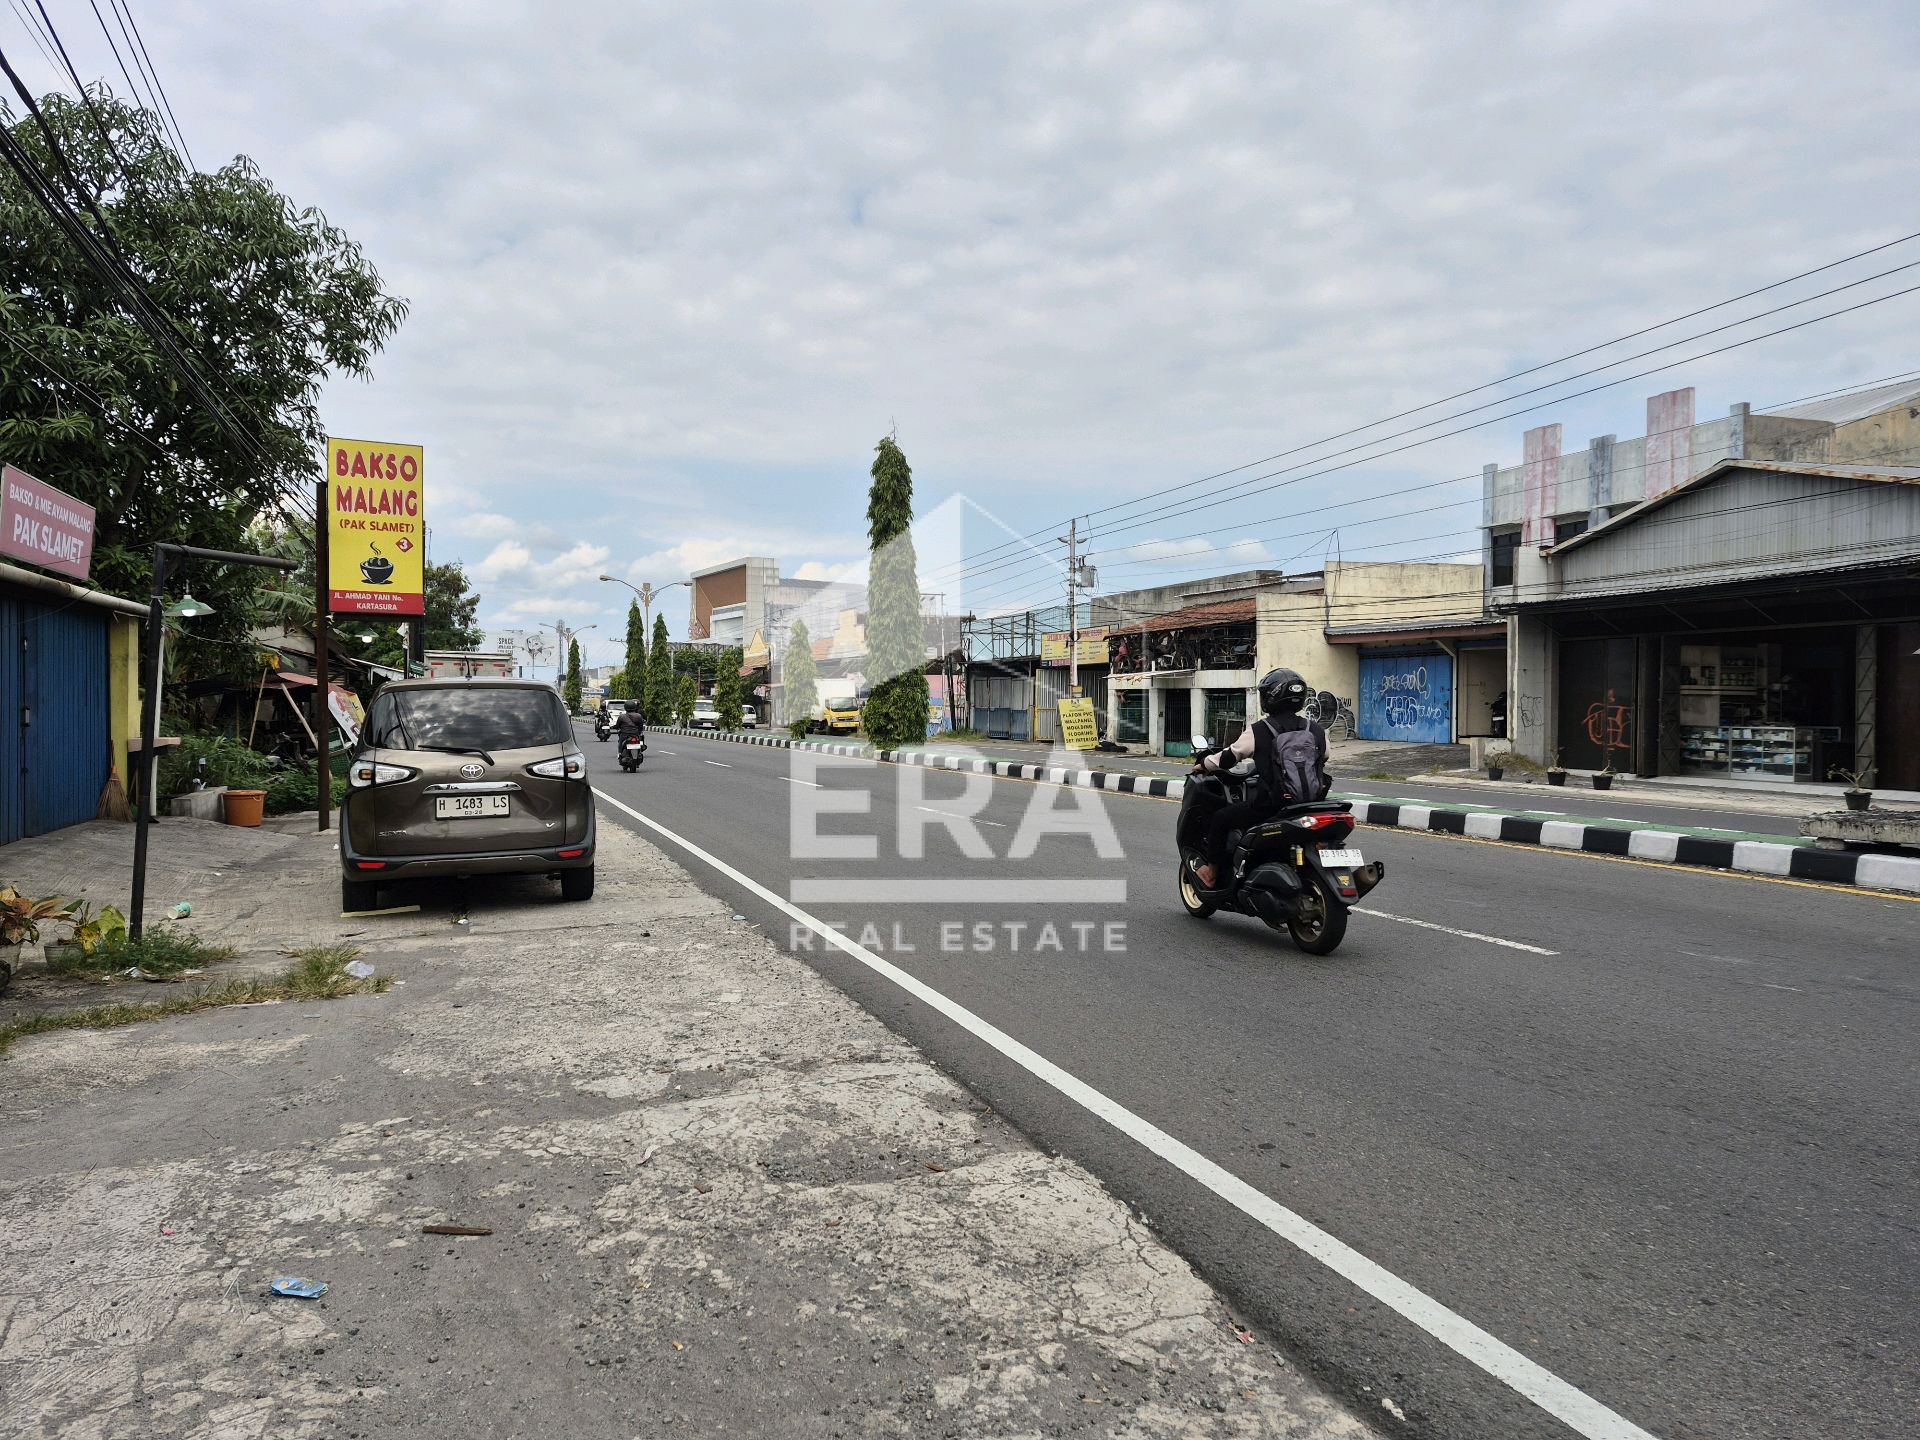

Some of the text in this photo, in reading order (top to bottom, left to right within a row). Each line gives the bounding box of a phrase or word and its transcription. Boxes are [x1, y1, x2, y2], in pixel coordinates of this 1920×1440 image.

[336, 448, 418, 482] BAKSO
[10, 483, 91, 533] BAKSO & MIE AYAM MALANG
[336, 484, 418, 517] MALANG
[339, 518, 415, 533] (PAK SLAMET)
[13, 513, 84, 564] PAK SLAMET
[399, 539, 408, 550] 3
[345, 592, 372, 600] AHMAD
[356, 602, 398, 611] KARTASURA
[439, 796, 507, 811] H 1483 LS
